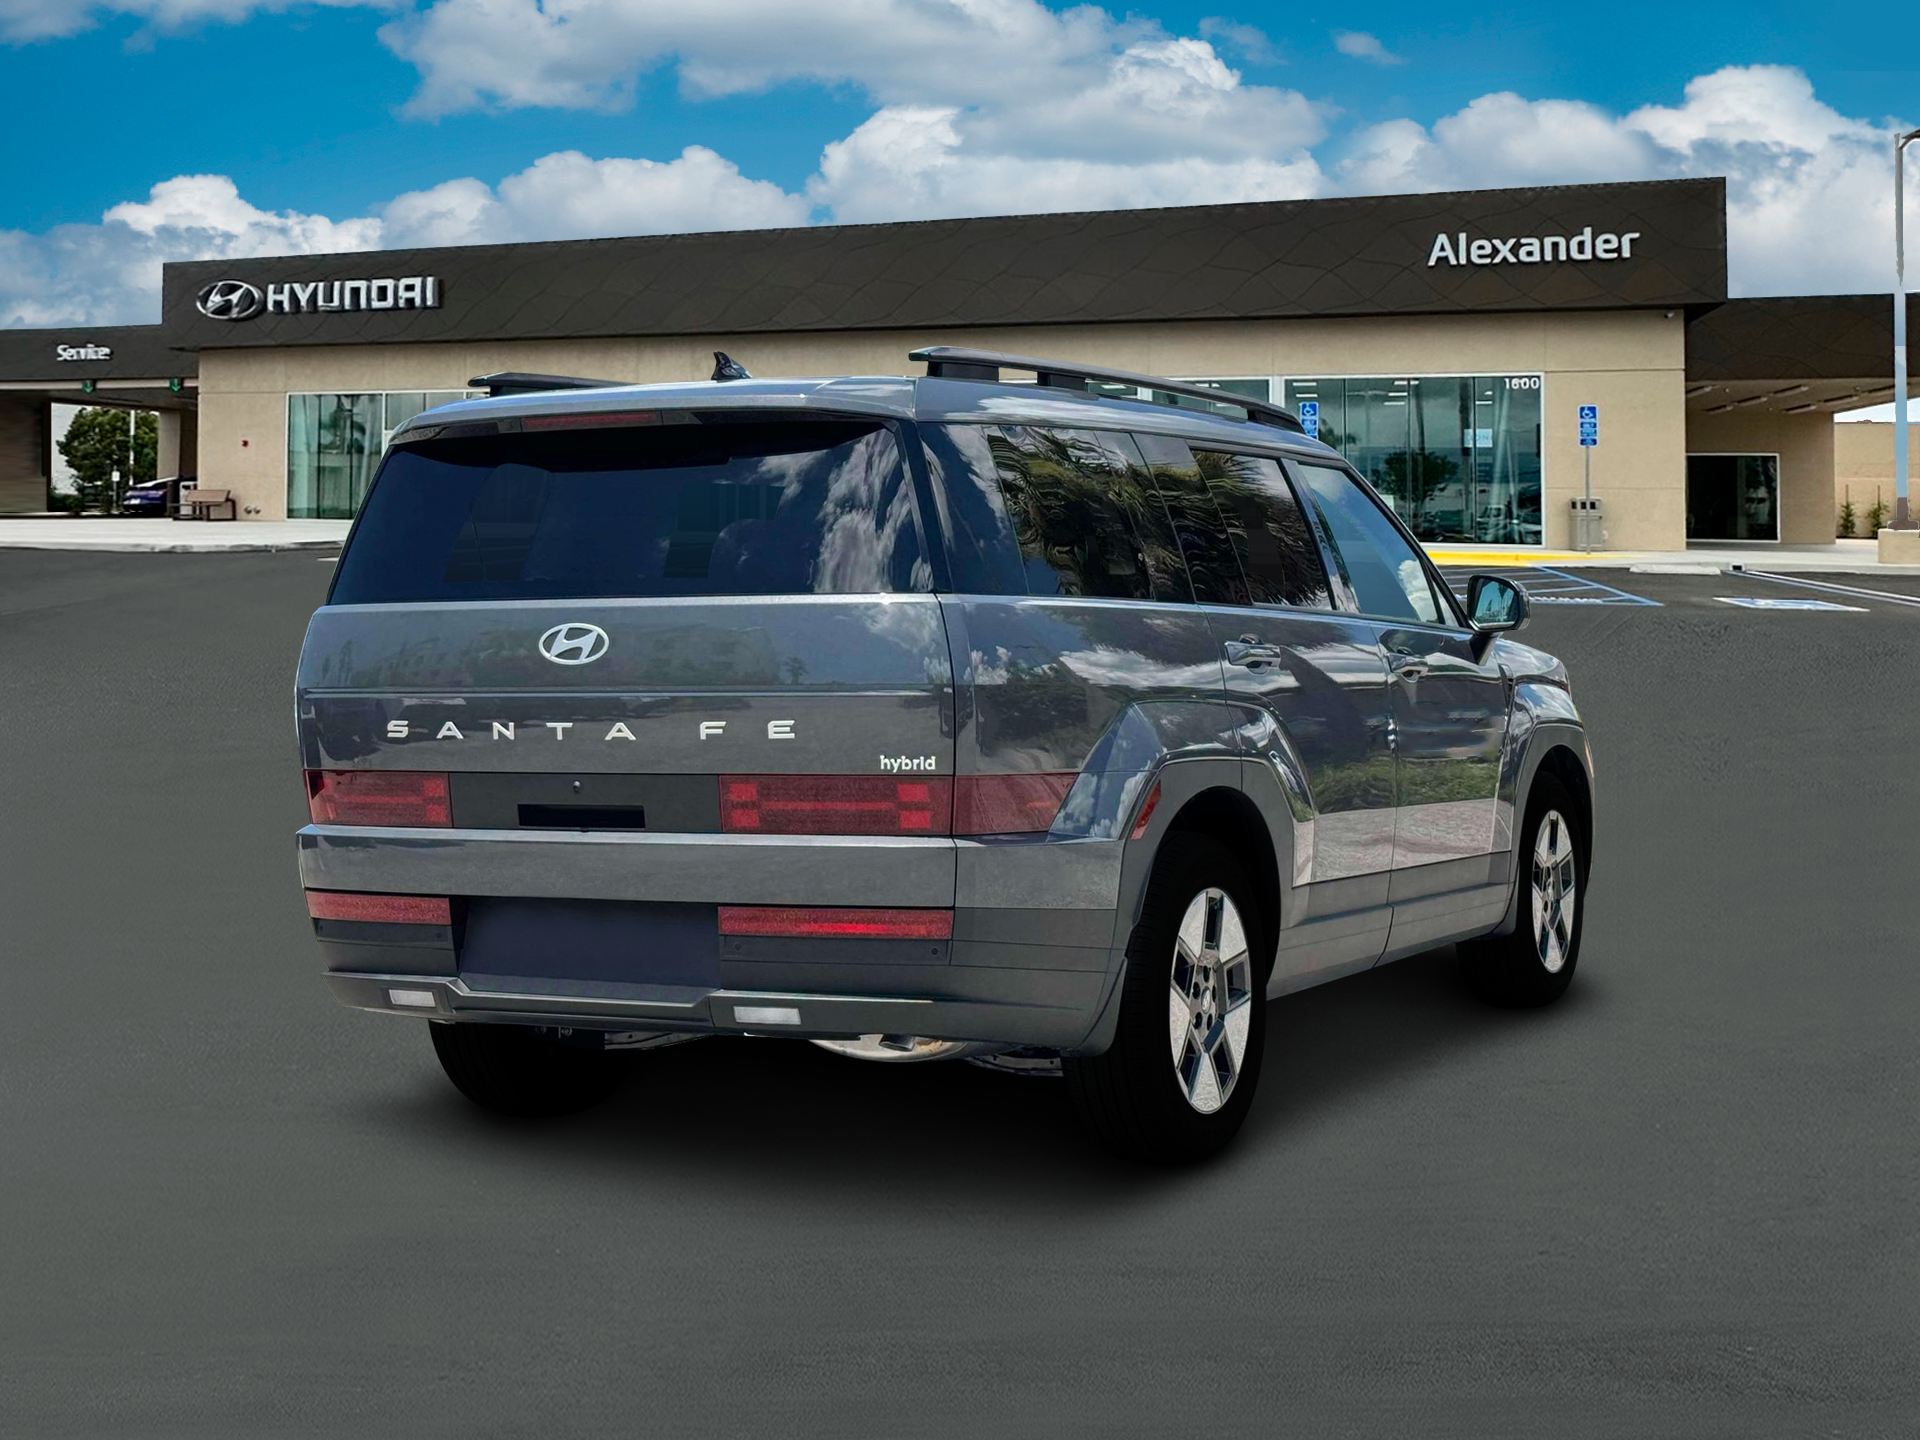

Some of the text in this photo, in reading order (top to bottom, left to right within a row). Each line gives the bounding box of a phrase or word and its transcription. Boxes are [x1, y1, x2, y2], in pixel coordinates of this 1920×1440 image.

[1427, 226, 1641, 267] Alexander
[266, 276, 438, 313] HYUNDAI
[56, 343, 111, 361] Service
[1504, 377, 1540, 389] 1600
[386, 719, 797, 741] SANTA FE
[879, 754, 937, 773] hybrid
